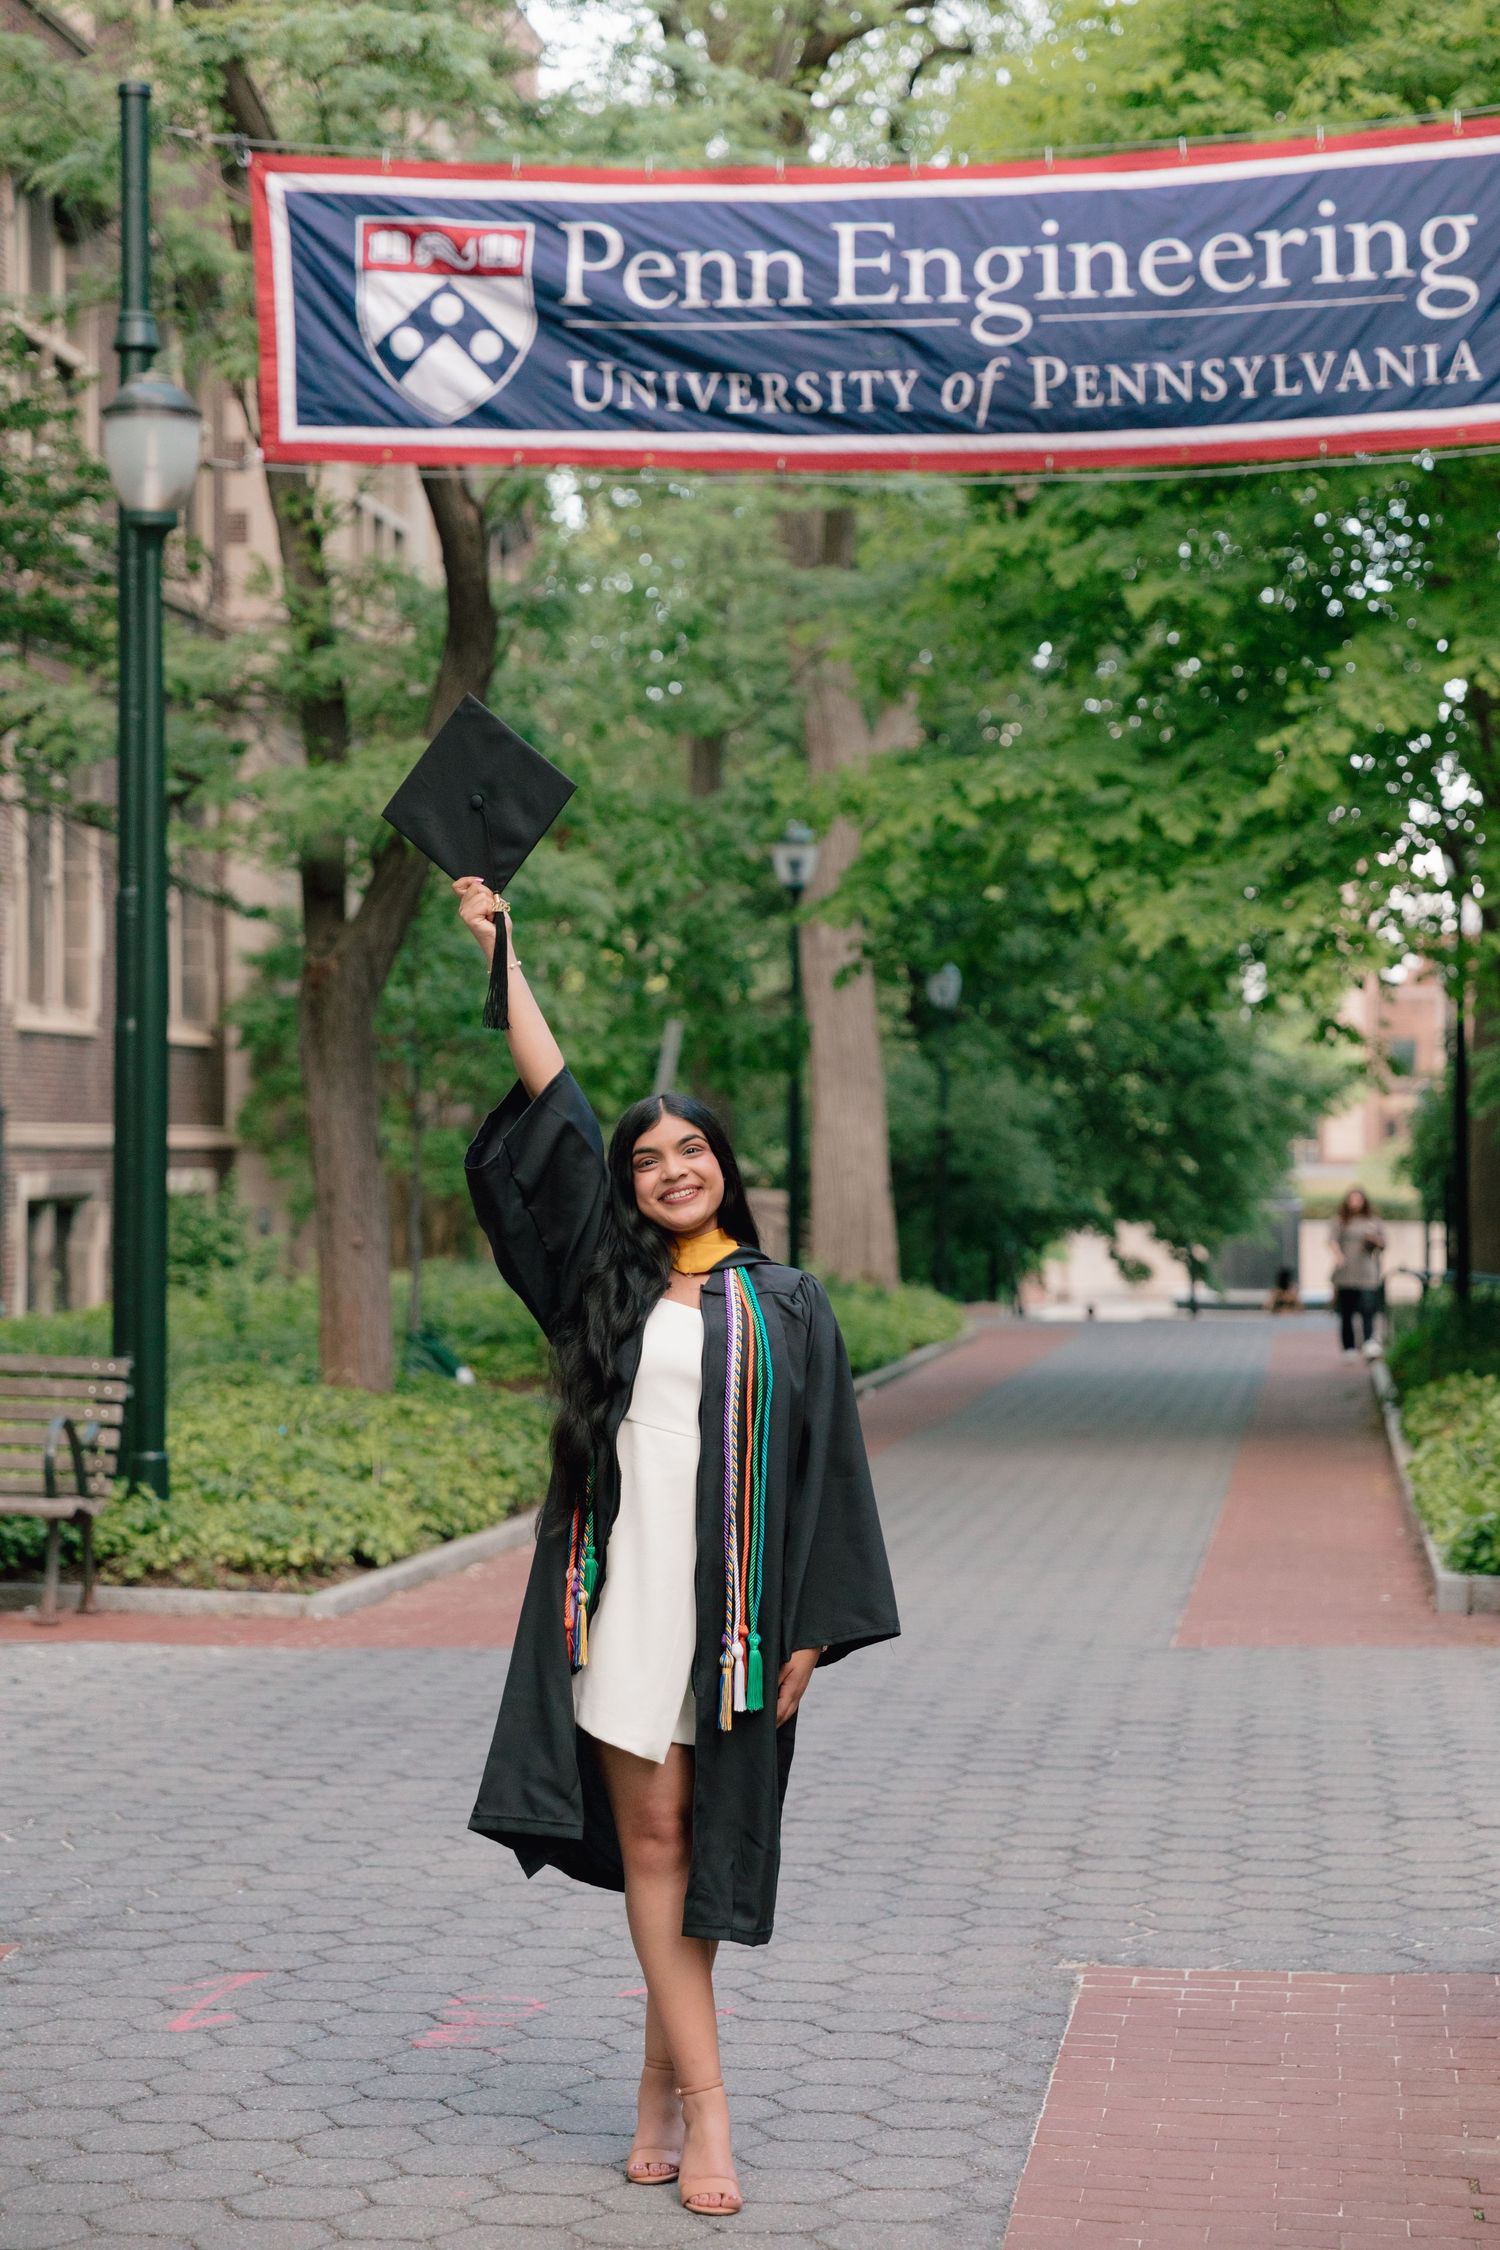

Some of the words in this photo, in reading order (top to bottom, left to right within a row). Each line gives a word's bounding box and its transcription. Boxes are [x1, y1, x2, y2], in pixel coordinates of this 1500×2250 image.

[559, 221, 812, 309] Penn
[830, 199, 1480, 347] Engineering
[567, 359, 920, 413] UNIVERSITY
[940, 356, 1011, 428] of
[1027, 340, 1483, 409] PENNSYLVANIA
